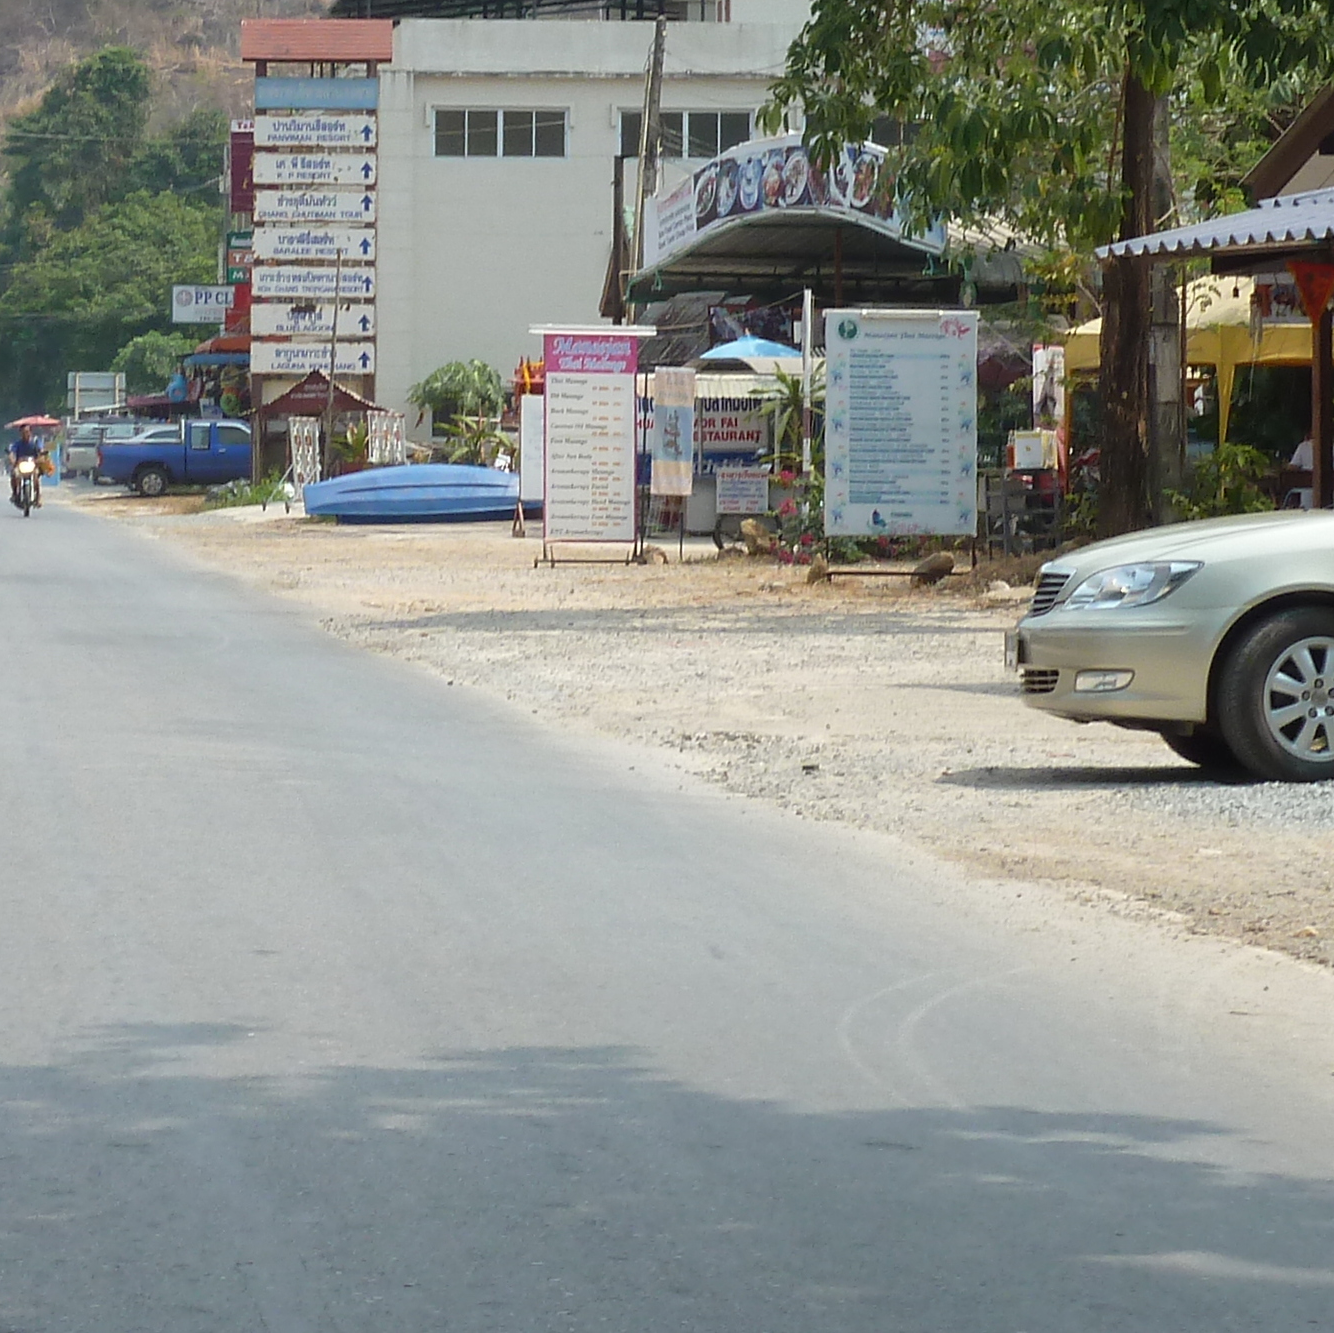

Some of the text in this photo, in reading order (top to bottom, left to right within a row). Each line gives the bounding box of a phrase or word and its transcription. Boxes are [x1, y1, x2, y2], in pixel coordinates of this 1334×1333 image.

[316, 134, 351, 142] RESORT
[296, 171, 331, 179] RESORT
[194, 291, 233, 305] PP CL
